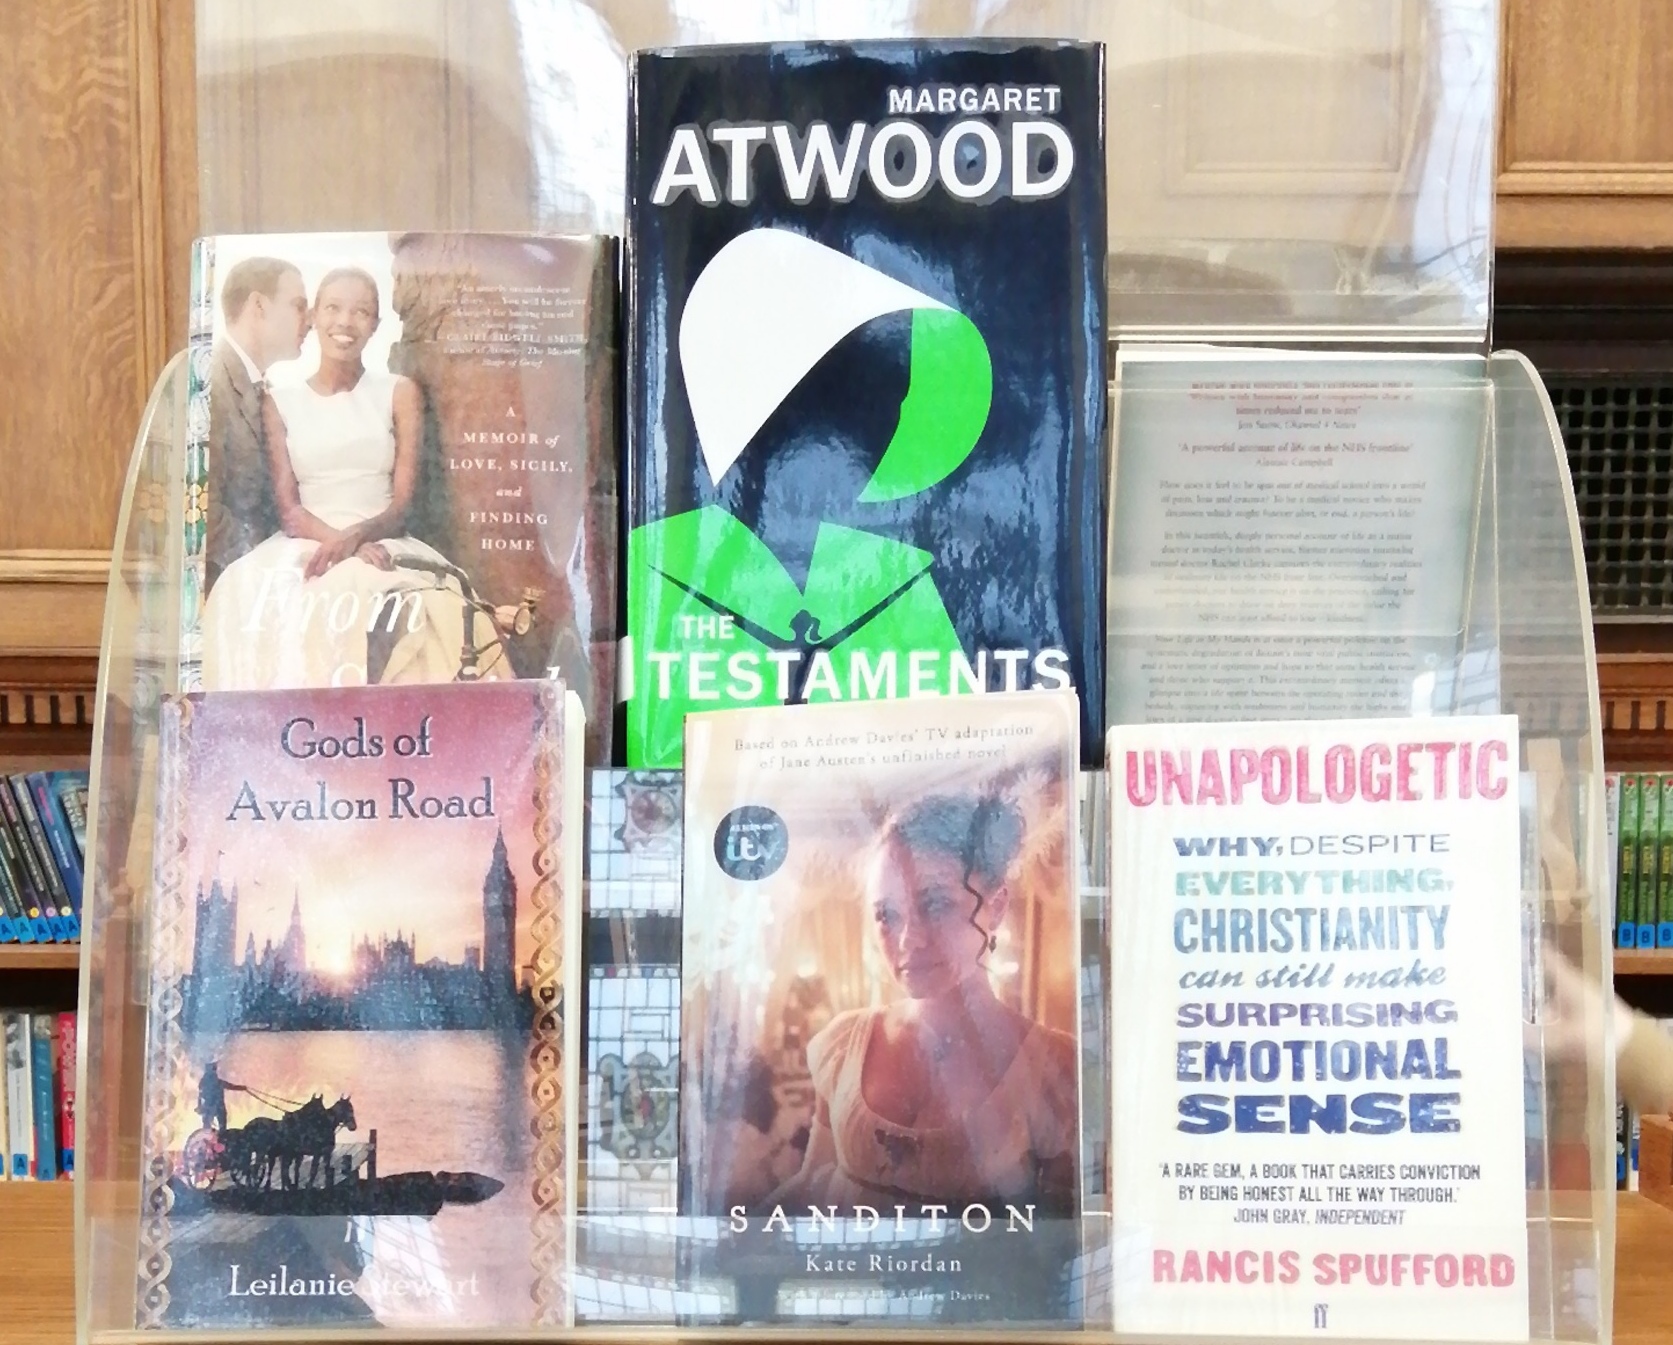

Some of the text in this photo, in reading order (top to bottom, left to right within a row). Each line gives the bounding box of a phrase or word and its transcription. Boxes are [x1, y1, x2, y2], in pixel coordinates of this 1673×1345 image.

[888, 86, 1061, 113] MARGARET
[651, 120, 1074, 201] ATWOOD
[505, 406, 516, 418] A
[463, 432, 560, 449] MEMOIR of
[450, 458, 573, 472] LOVE, SICILY,
[496, 486, 523, 498] and
[469, 511, 549, 525] FINDING
[481, 538, 536, 551] HOME
[241, 565, 427, 633] From
[681, 614, 735, 640] THE
[648, 647, 1072, 701] TESTAMENTS
[281, 714, 433, 759] Gods of
[734, 737, 776, 752] Based
[780, 738, 799, 750] on
[804, 733, 861, 749] Andrew
[925, 726, 950, 742] TV
[954, 723, 1035, 744] adaptation
[759, 744, 1007, 771] of Jane Austen's unfinished novel
[1125, 738, 1510, 808] UNAPOLOGETIC
[226, 776, 496, 822] Avalon Road
[726, 834, 779, 863] itv
[1173, 833, 1451, 858] WHY, DESPITE
[1174, 866, 1455, 897] EVERYTHING,
[1173, 904, 1452, 955] CHRISTIANITY
[1178, 958, 1448, 991] can still make
[1175, 999, 1459, 1029] SURPRISING
[1175, 1036, 1463, 1084] EMOTIONAL
[1175, 1091, 1462, 1136] SENSE
[1174, 1162, 1209, 1179] RARE
[1212, 1163, 1245, 1182] GEM,
[1249, 1164, 1259, 1179] A
[1262, 1163, 1298, 1180] BOOK
[1301, 1163, 1335, 1180] THAT
[1338, 1163, 1397, 1181] CARRIES
[1400, 1164, 1482, 1181] CONVICTION
[1178, 1185, 1196, 1201] BY
[1199, 1185, 1239, 1202] BEING
[1242, 1185, 1296, 1202] HONEST
[1298, 1185, 1324, 1202] ALL
[1327, 1185, 1354, 1202] THE
[1356, 1185, 1386, 1202] WAY
[730, 1202, 1036, 1235] SANDITON
[1233, 1208, 1269, 1225] JOHN
[1314, 1208, 1407, 1226] INDEPENDENT
[805, 1253, 964, 1274] Kate Riordan
[1312, 1252, 1516, 1288] SPUFFORD
[229, 1264, 355, 1297] Leilanie
